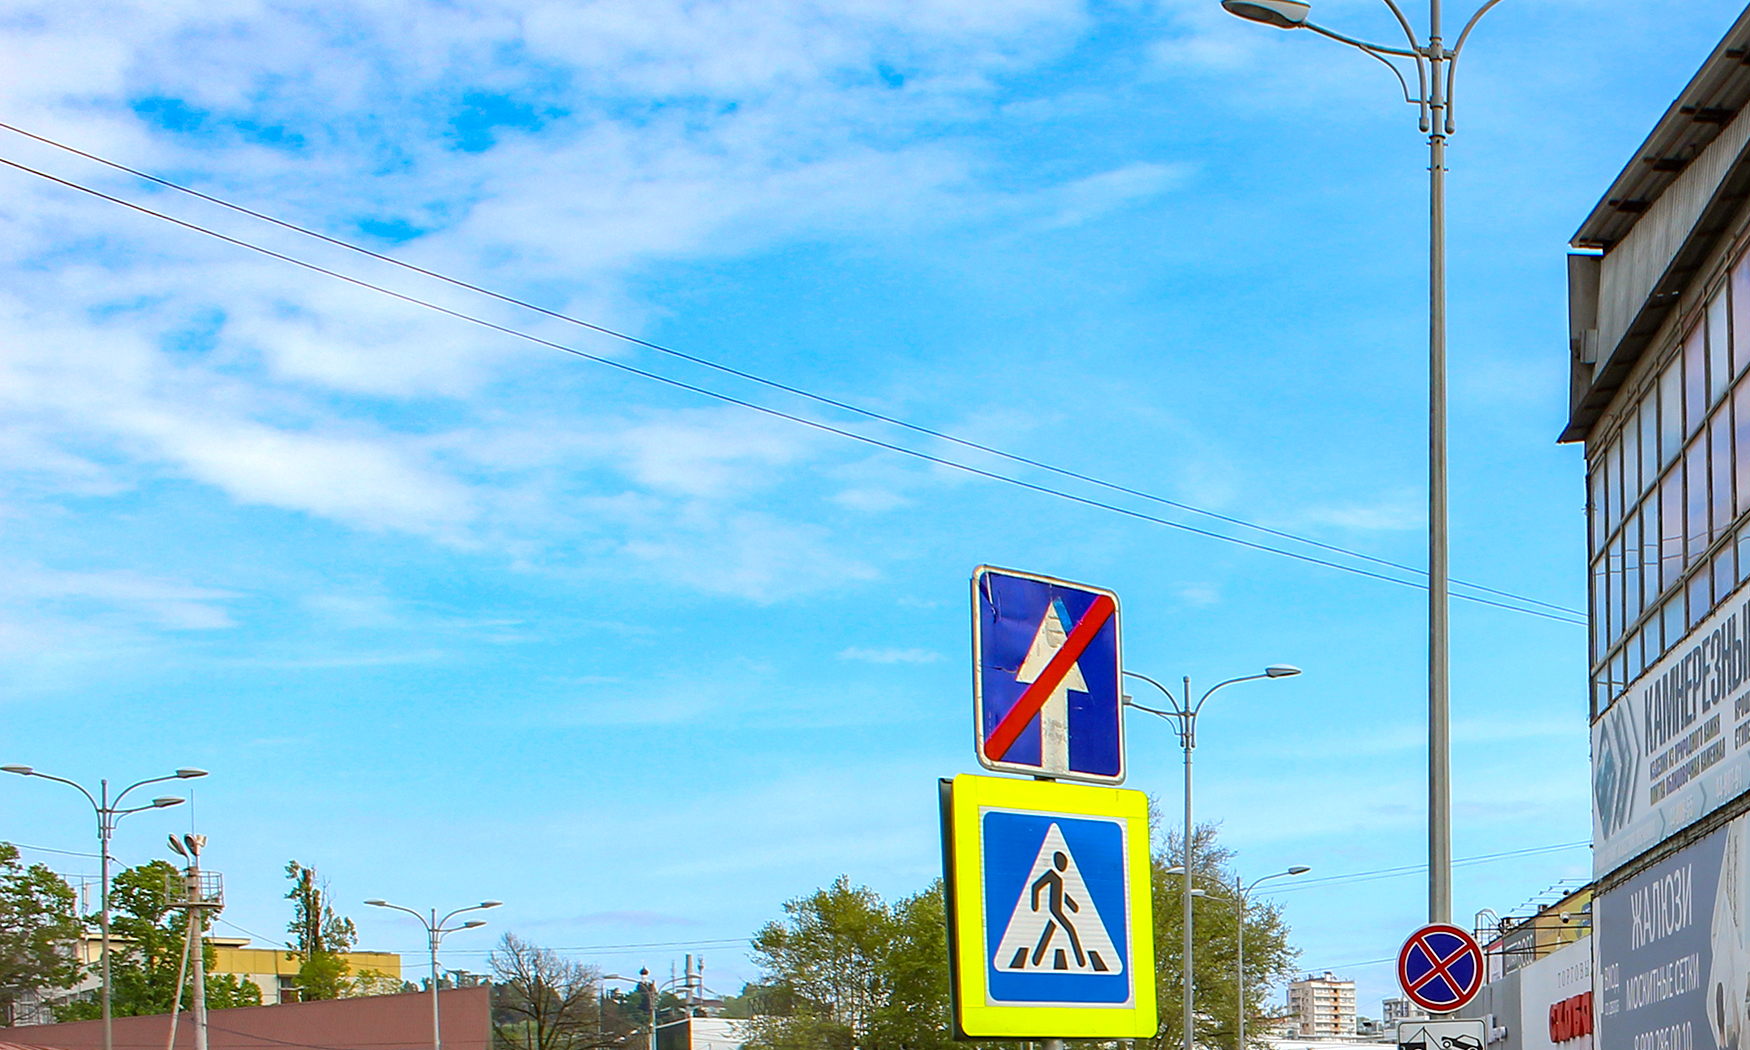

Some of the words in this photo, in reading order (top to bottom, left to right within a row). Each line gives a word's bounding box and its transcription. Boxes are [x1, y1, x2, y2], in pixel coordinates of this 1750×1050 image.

[1630, 863, 1693, 951] ЖАЛЮЗИ
[1626, 963, 1674, 1011] МОСКИТНЫЕ
[1674, 952, 1700, 996] СЕТКИ
